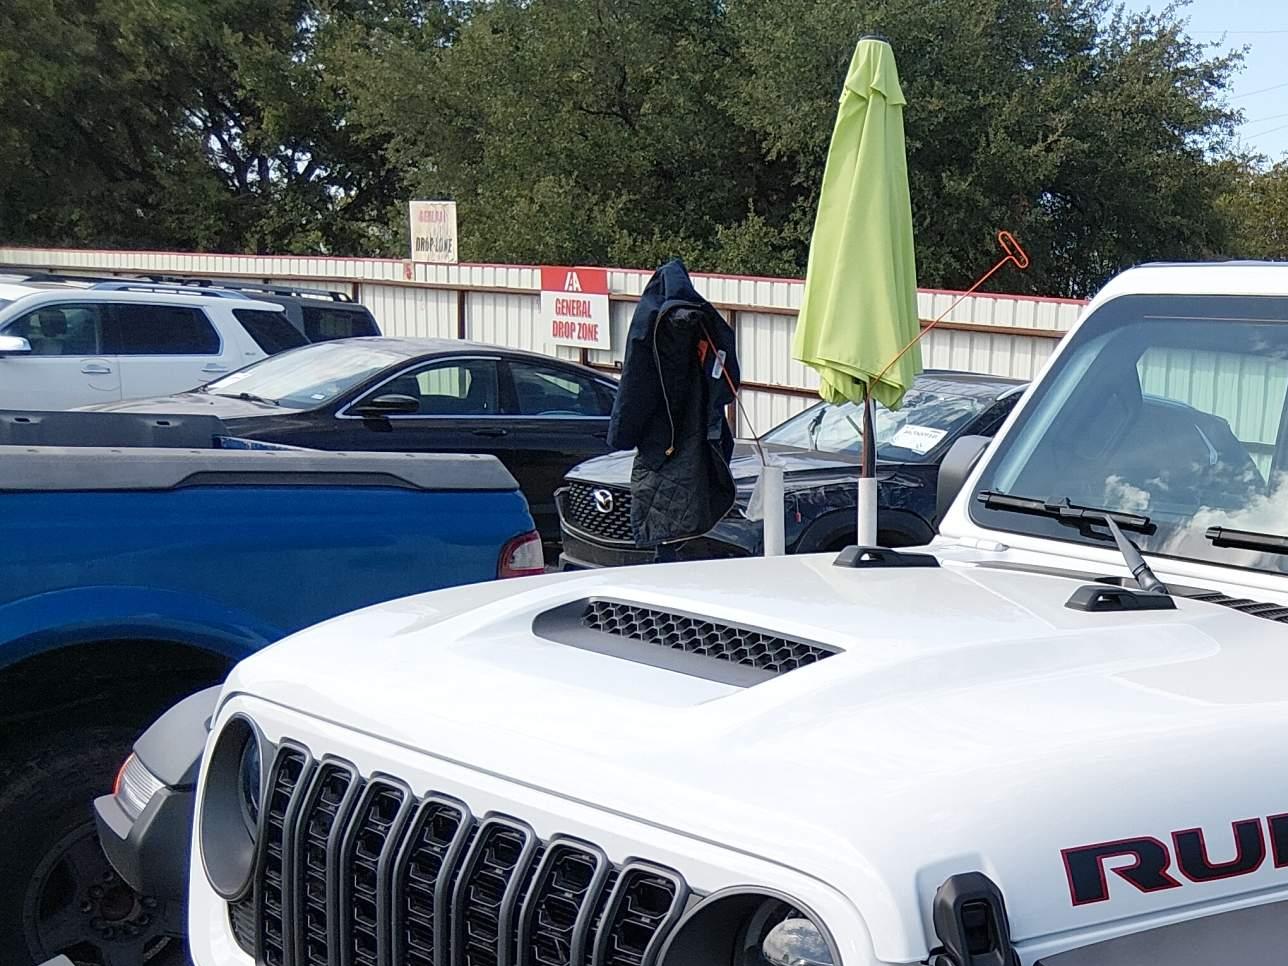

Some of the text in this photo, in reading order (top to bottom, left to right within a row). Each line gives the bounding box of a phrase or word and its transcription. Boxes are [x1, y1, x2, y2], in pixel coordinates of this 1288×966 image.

[555, 298, 592, 318] GENERAL
[552, 320, 599, 342] DROP ZONE
